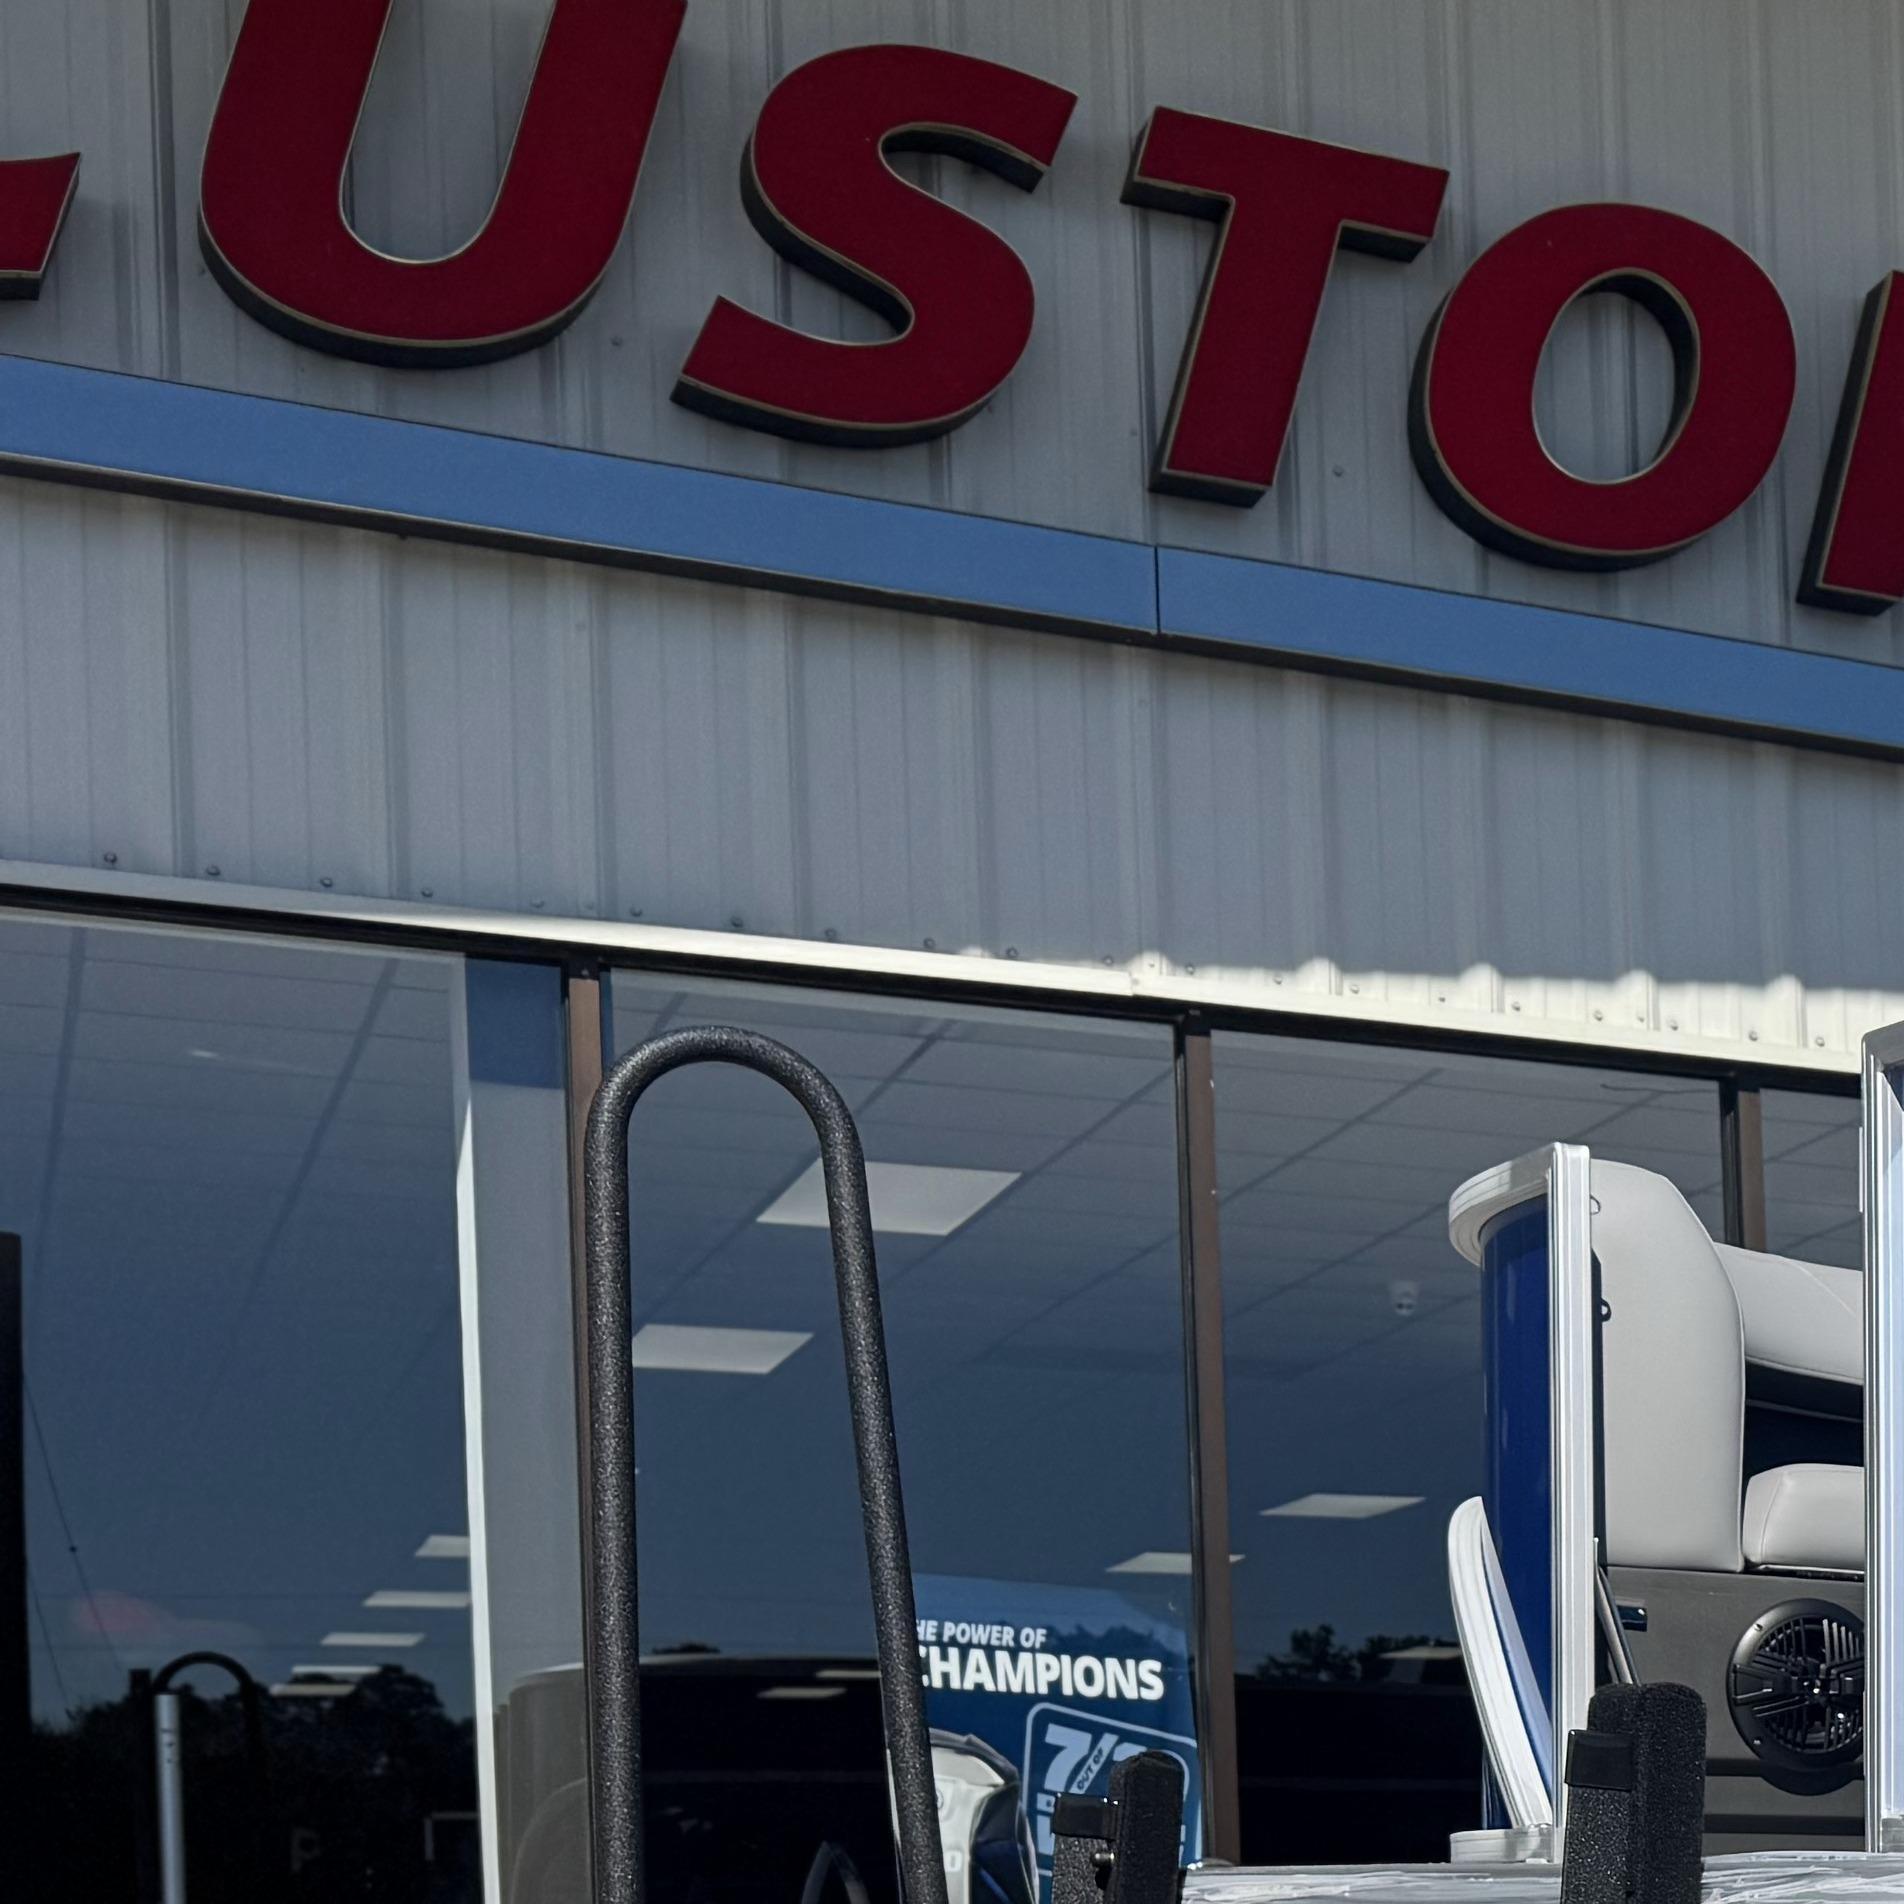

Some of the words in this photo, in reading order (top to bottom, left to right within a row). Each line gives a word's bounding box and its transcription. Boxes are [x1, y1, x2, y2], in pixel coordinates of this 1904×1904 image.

[915, 1619, 937, 1641] HE
[943, 1621, 1015, 1647] POWER
[1020, 1627, 1048, 1649] OF
